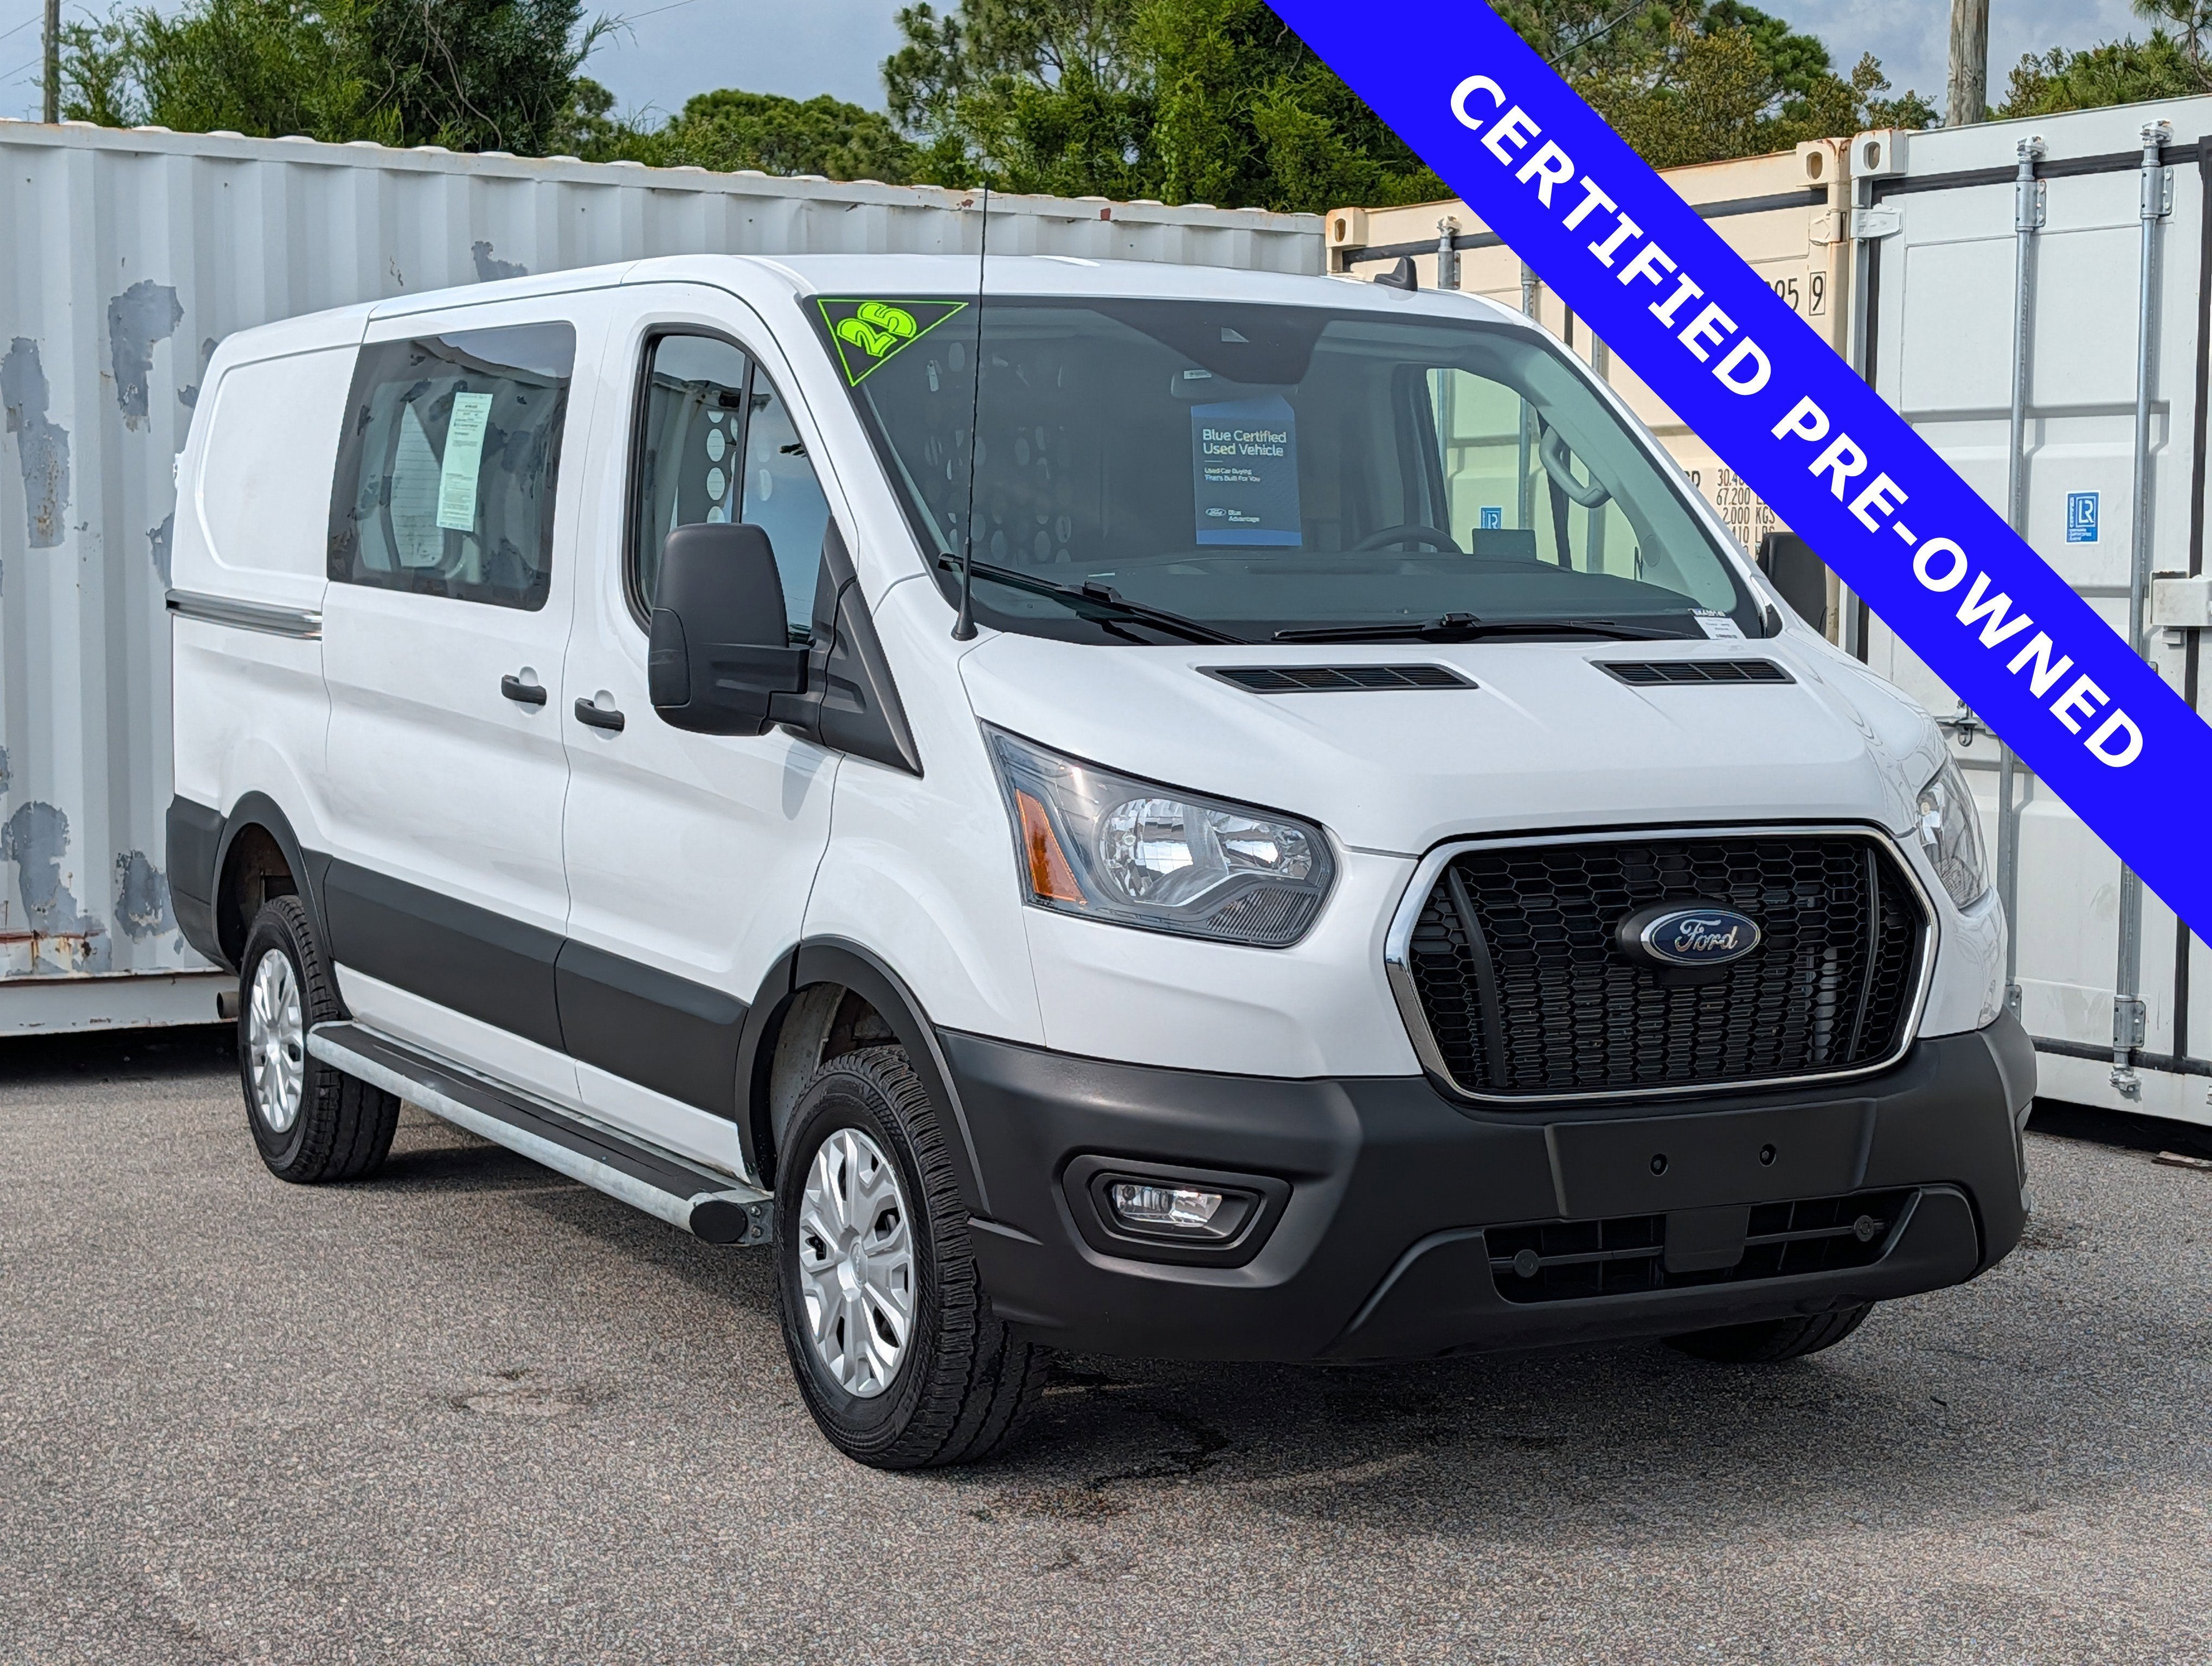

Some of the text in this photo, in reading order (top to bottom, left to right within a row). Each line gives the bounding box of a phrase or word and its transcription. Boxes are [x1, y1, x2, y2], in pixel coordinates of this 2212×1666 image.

[1812, 275, 1823, 311] 9
[837, 302, 917, 357] 25
[1203, 429, 1287, 443] Blue Certified
[1203, 443, 1284, 457] Used Vehicle
[1756, 506, 1775, 524] KGS
[1675, 919, 1738, 952] Ford
